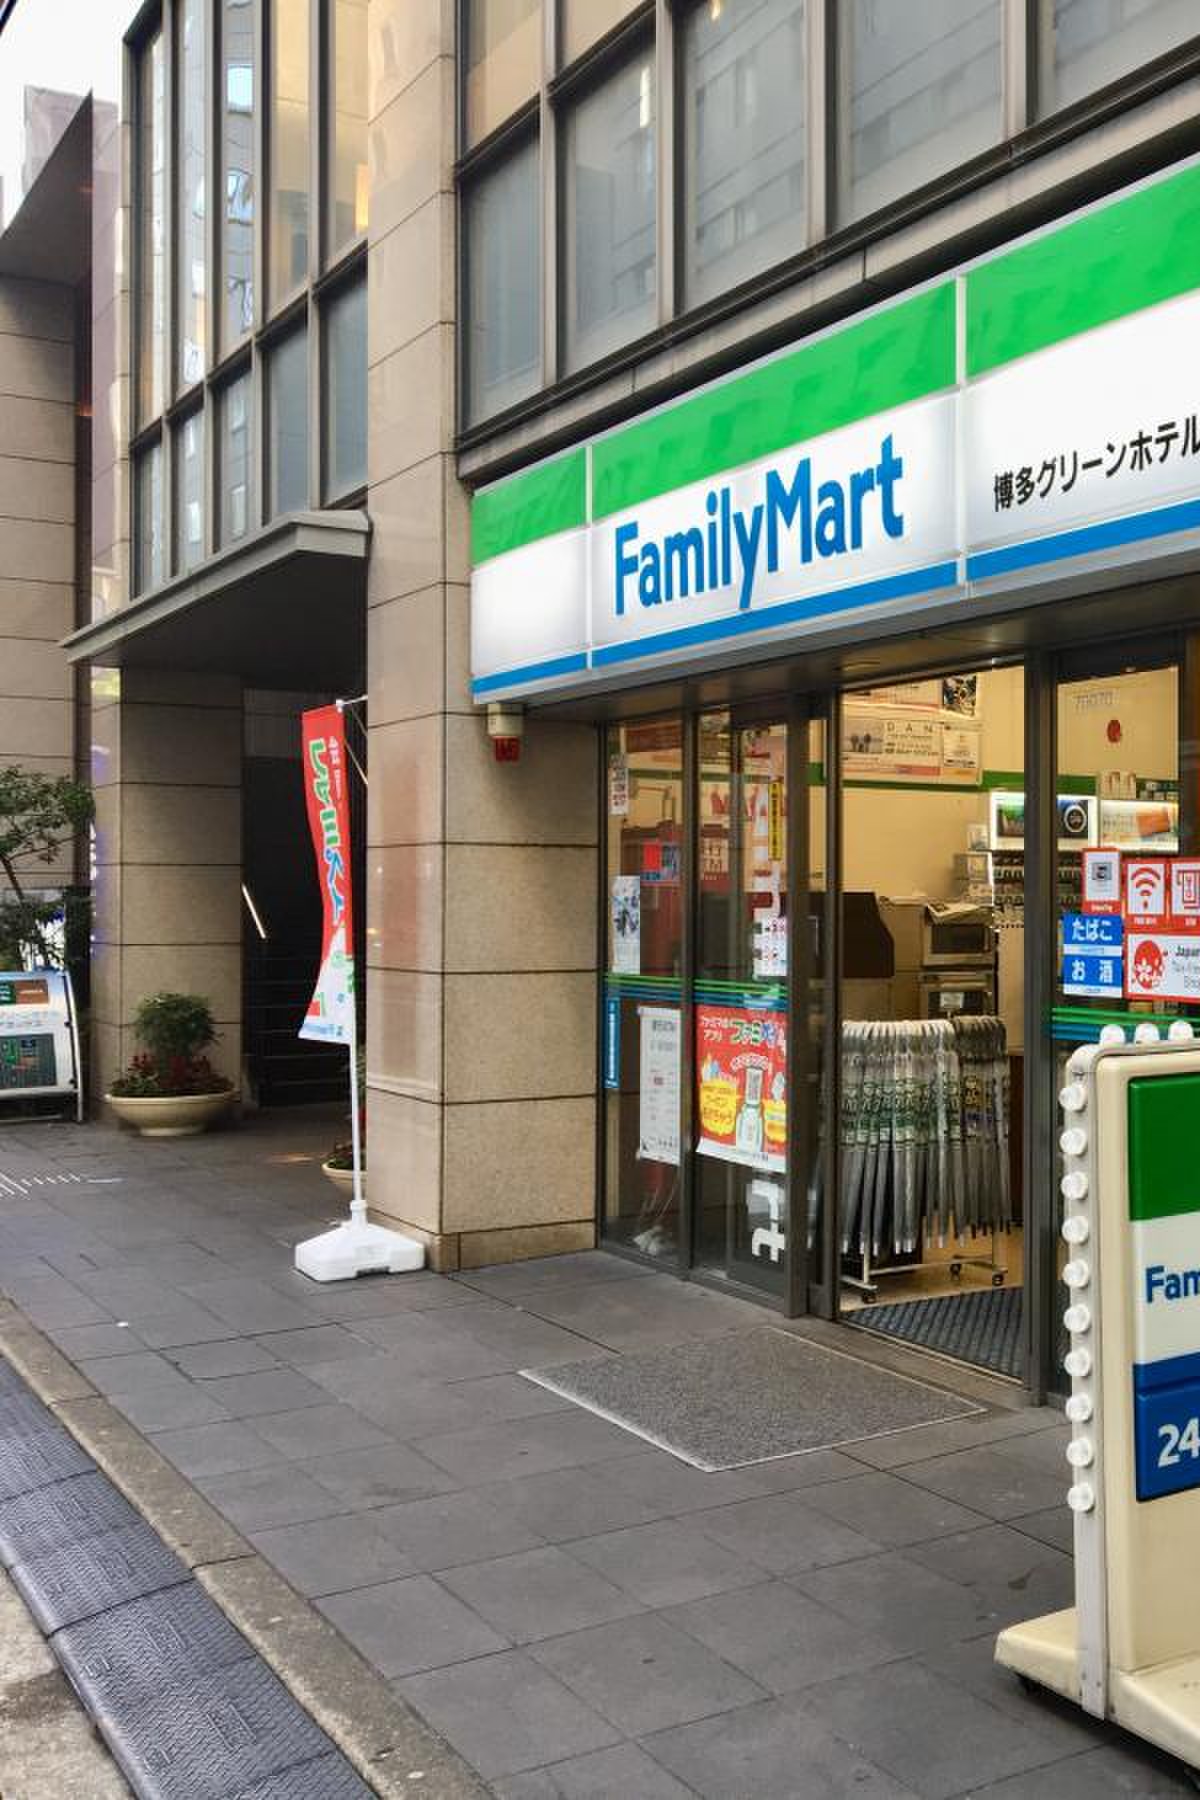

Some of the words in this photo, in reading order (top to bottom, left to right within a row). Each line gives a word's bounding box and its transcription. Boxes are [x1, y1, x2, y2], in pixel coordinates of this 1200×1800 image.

[614, 432, 904, 614] FamilyMart
[1071, 917, 1114, 942] たばこ
